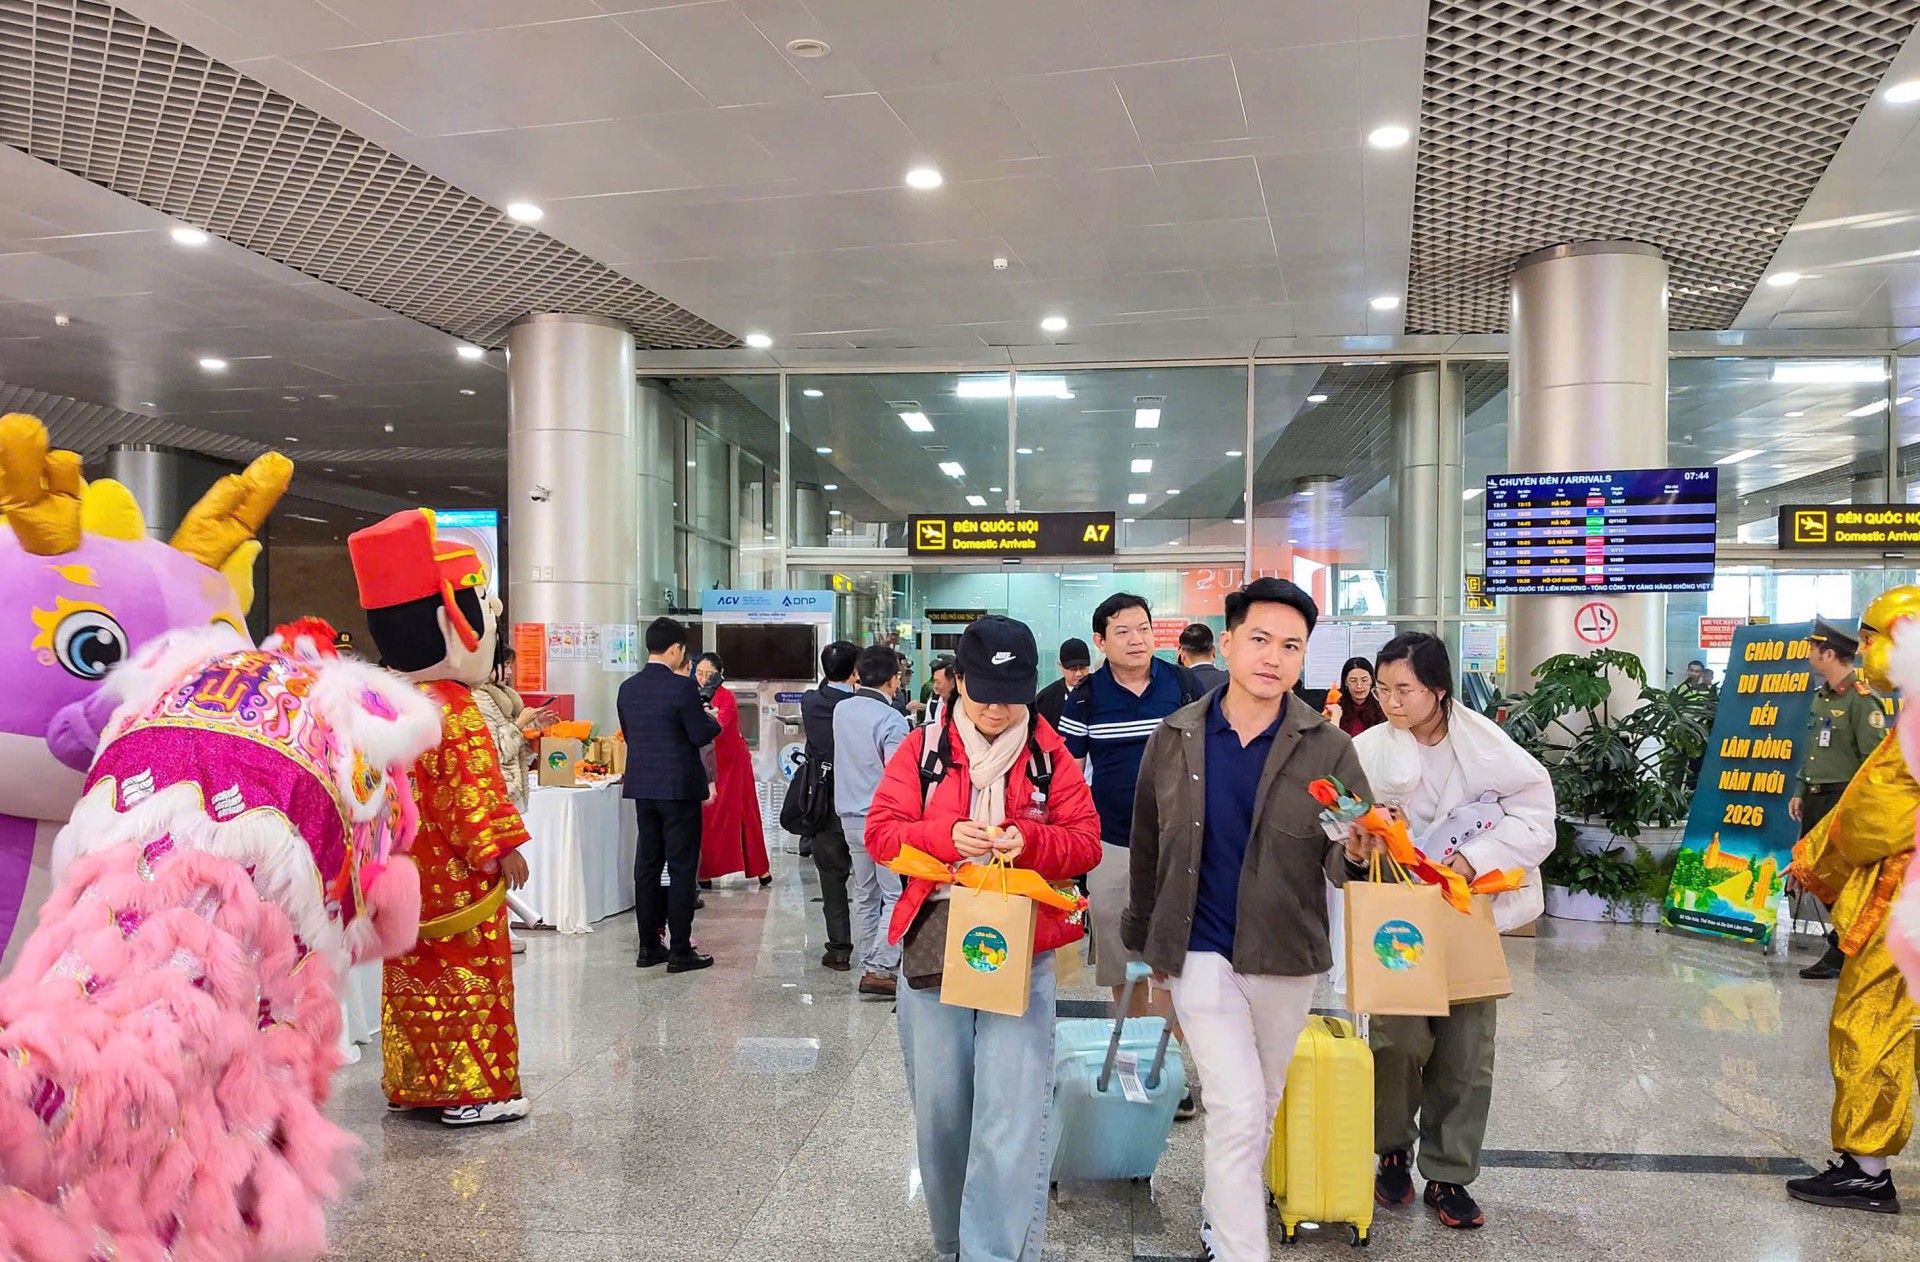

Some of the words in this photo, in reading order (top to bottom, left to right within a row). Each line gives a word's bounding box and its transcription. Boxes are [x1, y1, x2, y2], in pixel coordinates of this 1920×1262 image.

[1565, 475, 1612, 484] ARRIVALS
[1684, 472, 1709, 480] 07:44
[1864, 510, 1903, 525] QUỐC
[980, 519, 1015, 533] QUỐC
[1017, 520, 1039, 534] NỘI
[1083, 525, 1110, 542] A7
[953, 539, 998, 549] Domestic
[999, 539, 1036, 549] Arrivals
[1835, 531, 1885, 542] Domestic
[717, 596, 740, 605] ACV
[1744, 638, 1785, 662] CHÀO
[1737, 674, 1759, 694] DU
[1760, 671, 1810, 693] KHÁCH
[1749, 700, 1779, 726] ĐẾN
[1720, 735, 1751, 758] LÂM
[1751, 733, 1793, 760] ĐỒNG
[1718, 770, 1751, 792] NĂM
[1752, 769, 1786, 794] MỚI
[1723, 803, 1764, 827] 2026
